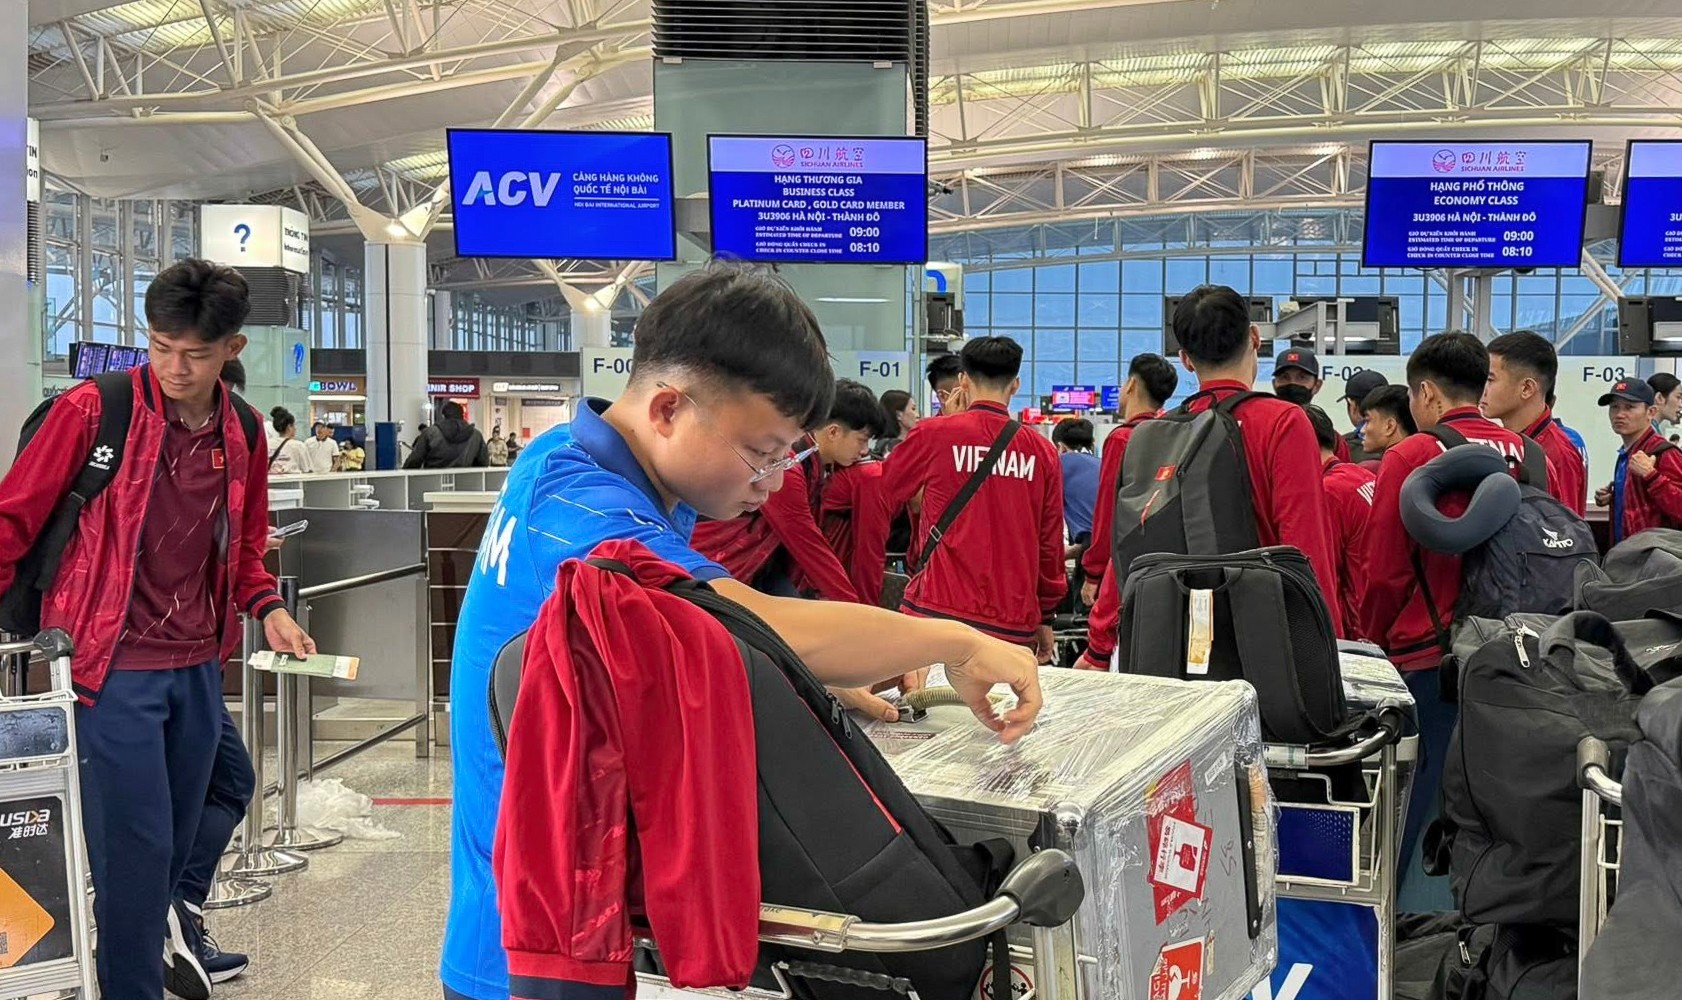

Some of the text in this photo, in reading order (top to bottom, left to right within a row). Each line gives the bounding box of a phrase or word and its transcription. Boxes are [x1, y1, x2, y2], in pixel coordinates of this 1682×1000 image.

[573, 171, 659, 182] CẢNG HÀNG KHÔNG
[774, 176, 863, 185] HẠNG THƯƠNG GIA
[462, 171, 561, 206] ACV
[574, 183, 647, 196] QUỐC TẾ NỘI BÀI
[1430, 179, 1524, 193] HẠNG PHỐ THÔNG
[783, 188, 826, 196] BUSINESS
[733, 200, 780, 208] PLATINUM
[782, 200, 806, 208] CARD
[813, 200, 838, 208] GOLD
[866, 202, 905, 210] MEMBER
[1434, 196, 1518, 205] ECONOMY CLASS
[758, 212, 790, 220] 3U3906
[792, 211, 805, 220] HÀ
[807, 211, 825, 222] NỘI
[832, 211, 864, 221] THÀNH
[866, 212, 880, 221] ĐÔ
[1413, 213, 1445, 221] 3U3906
[1447, 212, 1460, 221] HÀ
[1463, 212, 1481, 223] NỘI
[1488, 212, 1520, 221] THÀNH
[1522, 212, 1536, 221] ĐÔ
[849, 227, 879, 237] 09:00
[1504, 231, 1534, 241] 09:00
[850, 242, 879, 252] 08:10
[1502, 246, 1532, 256] 08:10
[860, 361, 899, 377] F-01
[1584, 367, 1625, 382] F-03
[320, 382, 357, 392] BOWL
[449, 384, 475, 392] SHOP
[952, 446, 1036, 481] VIENAM
[8, 823, 48, 839] 准时达
